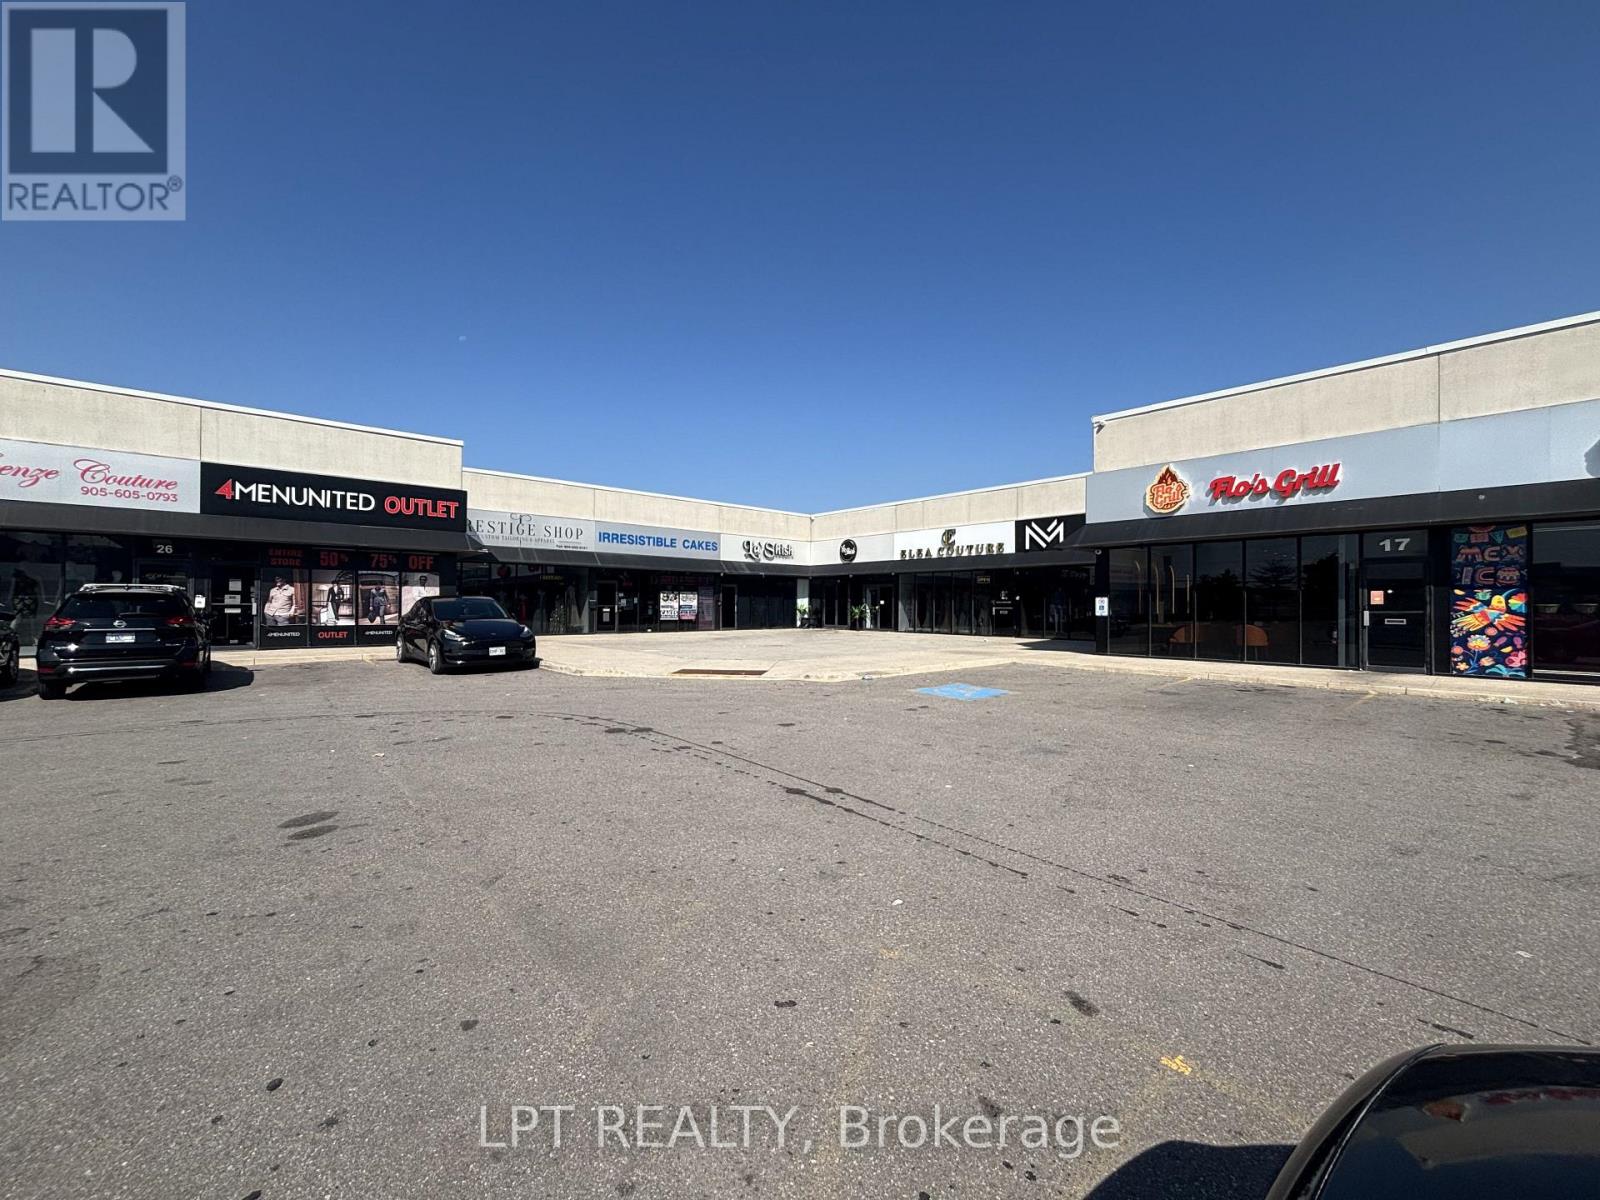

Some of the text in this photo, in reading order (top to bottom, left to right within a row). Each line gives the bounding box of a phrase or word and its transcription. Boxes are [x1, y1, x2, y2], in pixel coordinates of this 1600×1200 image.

[0, 459, 178, 490] enze Couture
[1209, 463, 1341, 500] Flo's Grill
[80, 486, 179, 502] 905-605-0793
[214, 478, 459, 519] 4MENUNITED OUTLET
[543, 525, 584, 540] SHOP
[156, 544, 174, 554] 26
[598, 531, 678, 549] IRRESISTIBLE
[682, 539, 719, 552] CAKES
[1378, 537, 1411, 552] 17
[937, 543, 1005, 558] COUTURE
[270, 557, 302, 566] STORE
[408, 555, 434, 570] OFF
[318, 631, 349, 639] OUTLET
